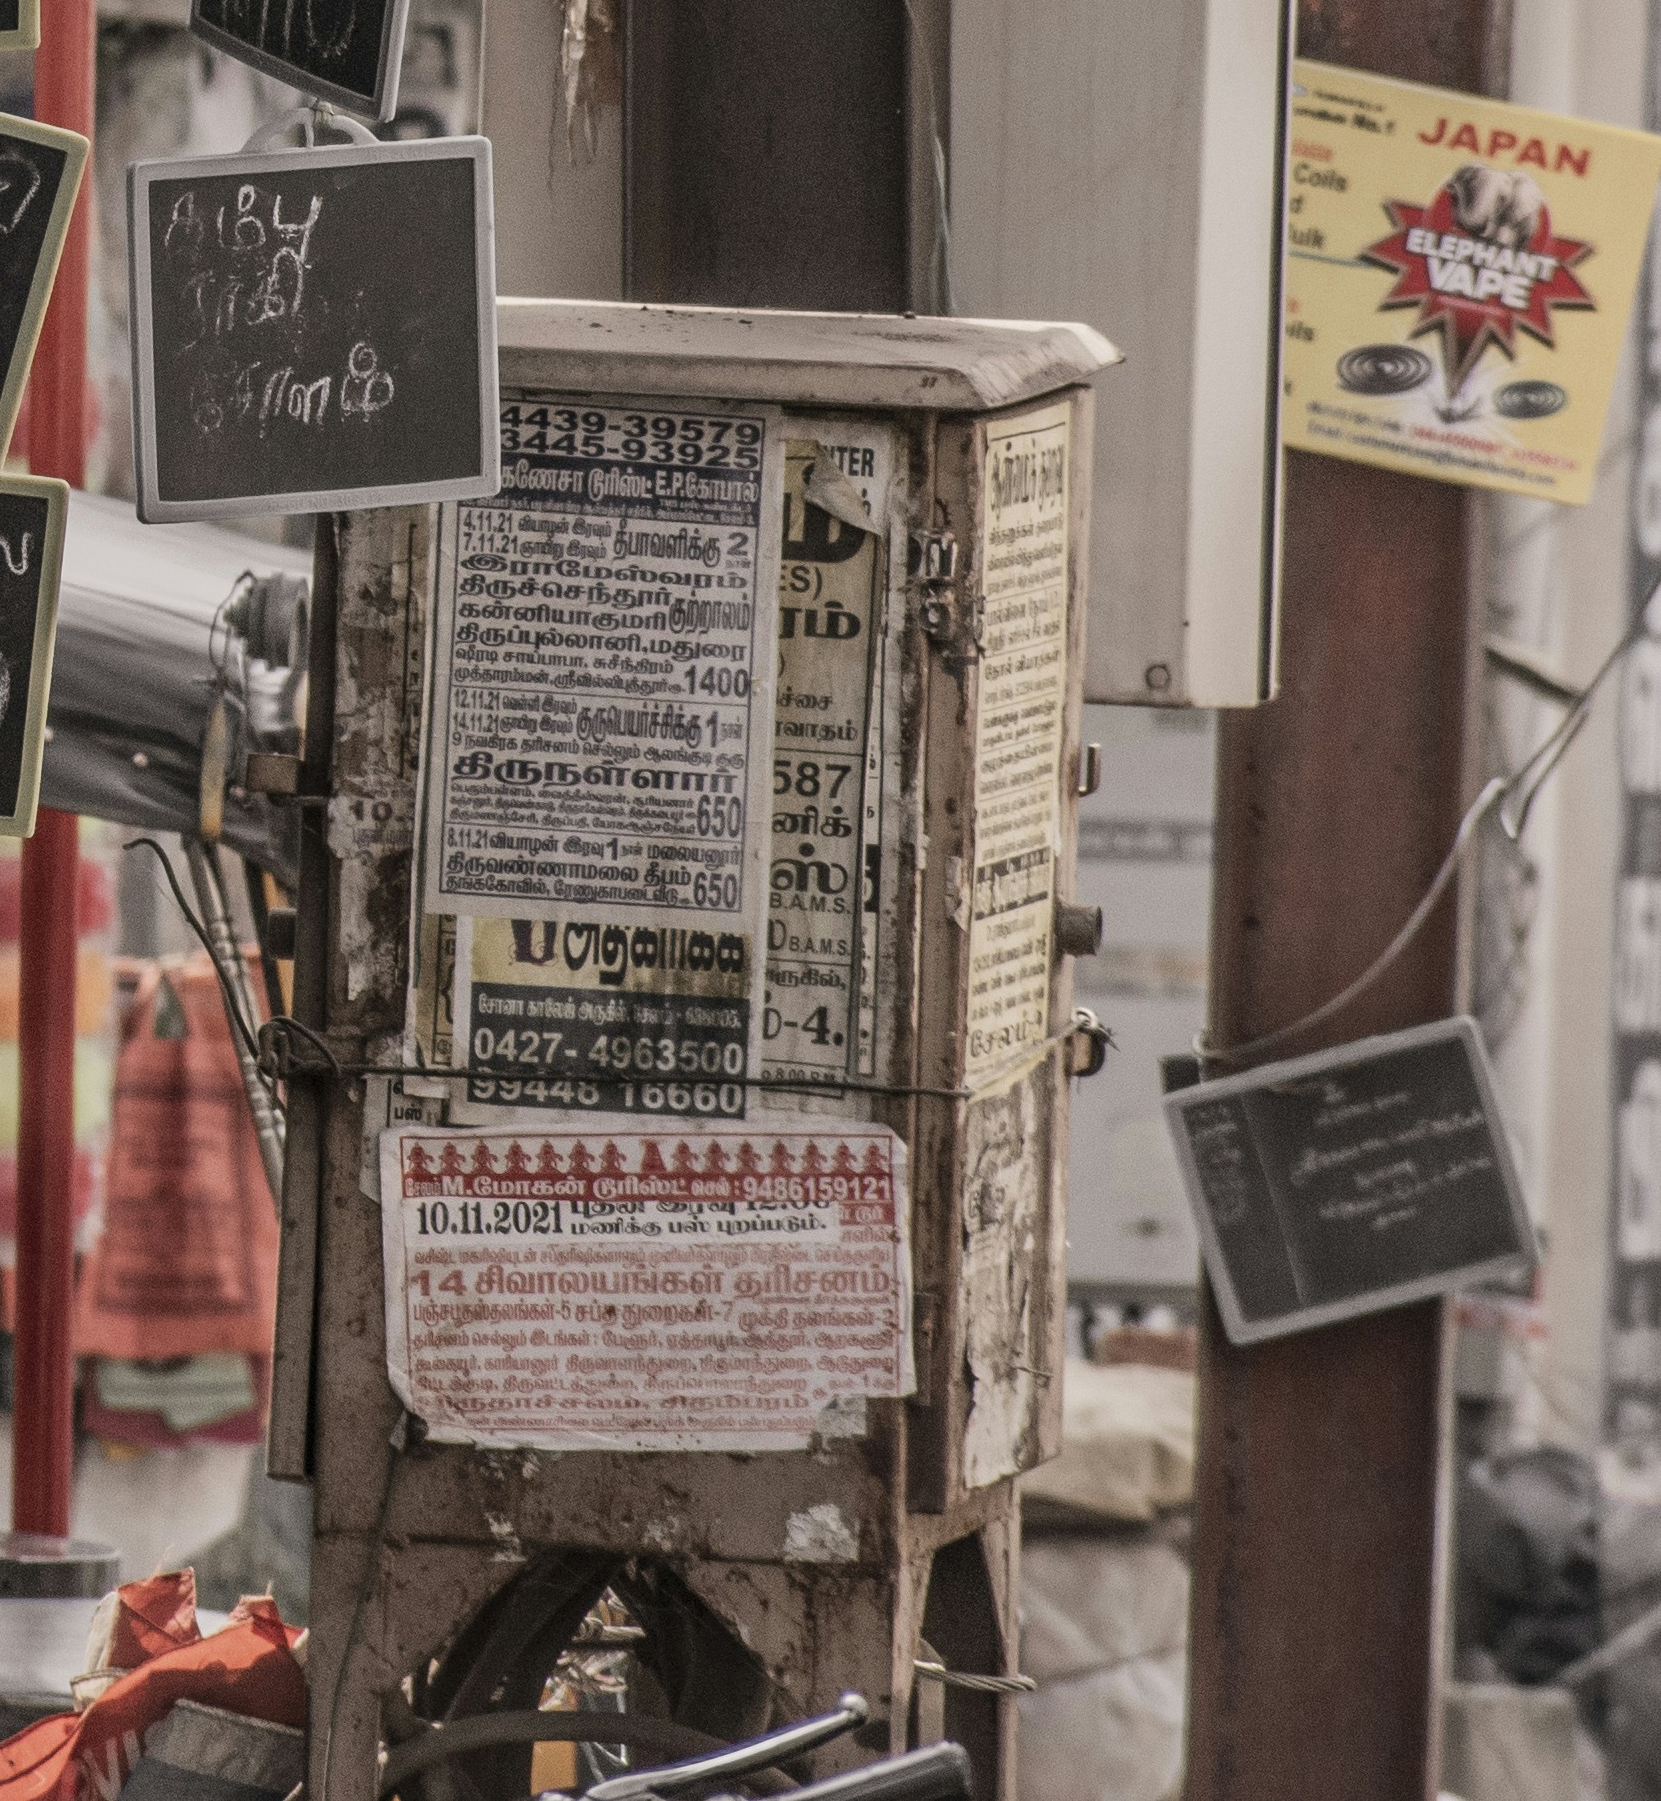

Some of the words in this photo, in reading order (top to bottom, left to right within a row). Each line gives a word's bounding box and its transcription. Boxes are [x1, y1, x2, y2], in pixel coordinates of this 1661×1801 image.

[1418, 116, 1593, 178] JAPAN
[1406, 226, 1560, 281] ELEPHANT
[1425, 258, 1533, 309] VAPE
[463, 513, 513, 534] 4.11.21
[463, 532, 518, 554] 7.11.21
[726, 532, 749, 556] 2
[461, 553, 748, 589] இராமேஸ்வரம்
[459, 600, 667, 631] கன்னியாகுமரி
[685, 664, 749, 698] 1400
[697, 795, 740, 839] 650
[693, 872, 738, 908] 650
[474, 1028, 576, 1064] 0427-
[589, 1034, 744, 1076] 4963500
[743, 1176, 890, 1202] 9486159121
[417, 1201, 565, 1235] 10.11.2021
[414, 1270, 467, 1297] 14
[475, 1264, 724, 1297] சிவாலயங்கள்
[733, 1266, 890, 1300] தரிசனம்
